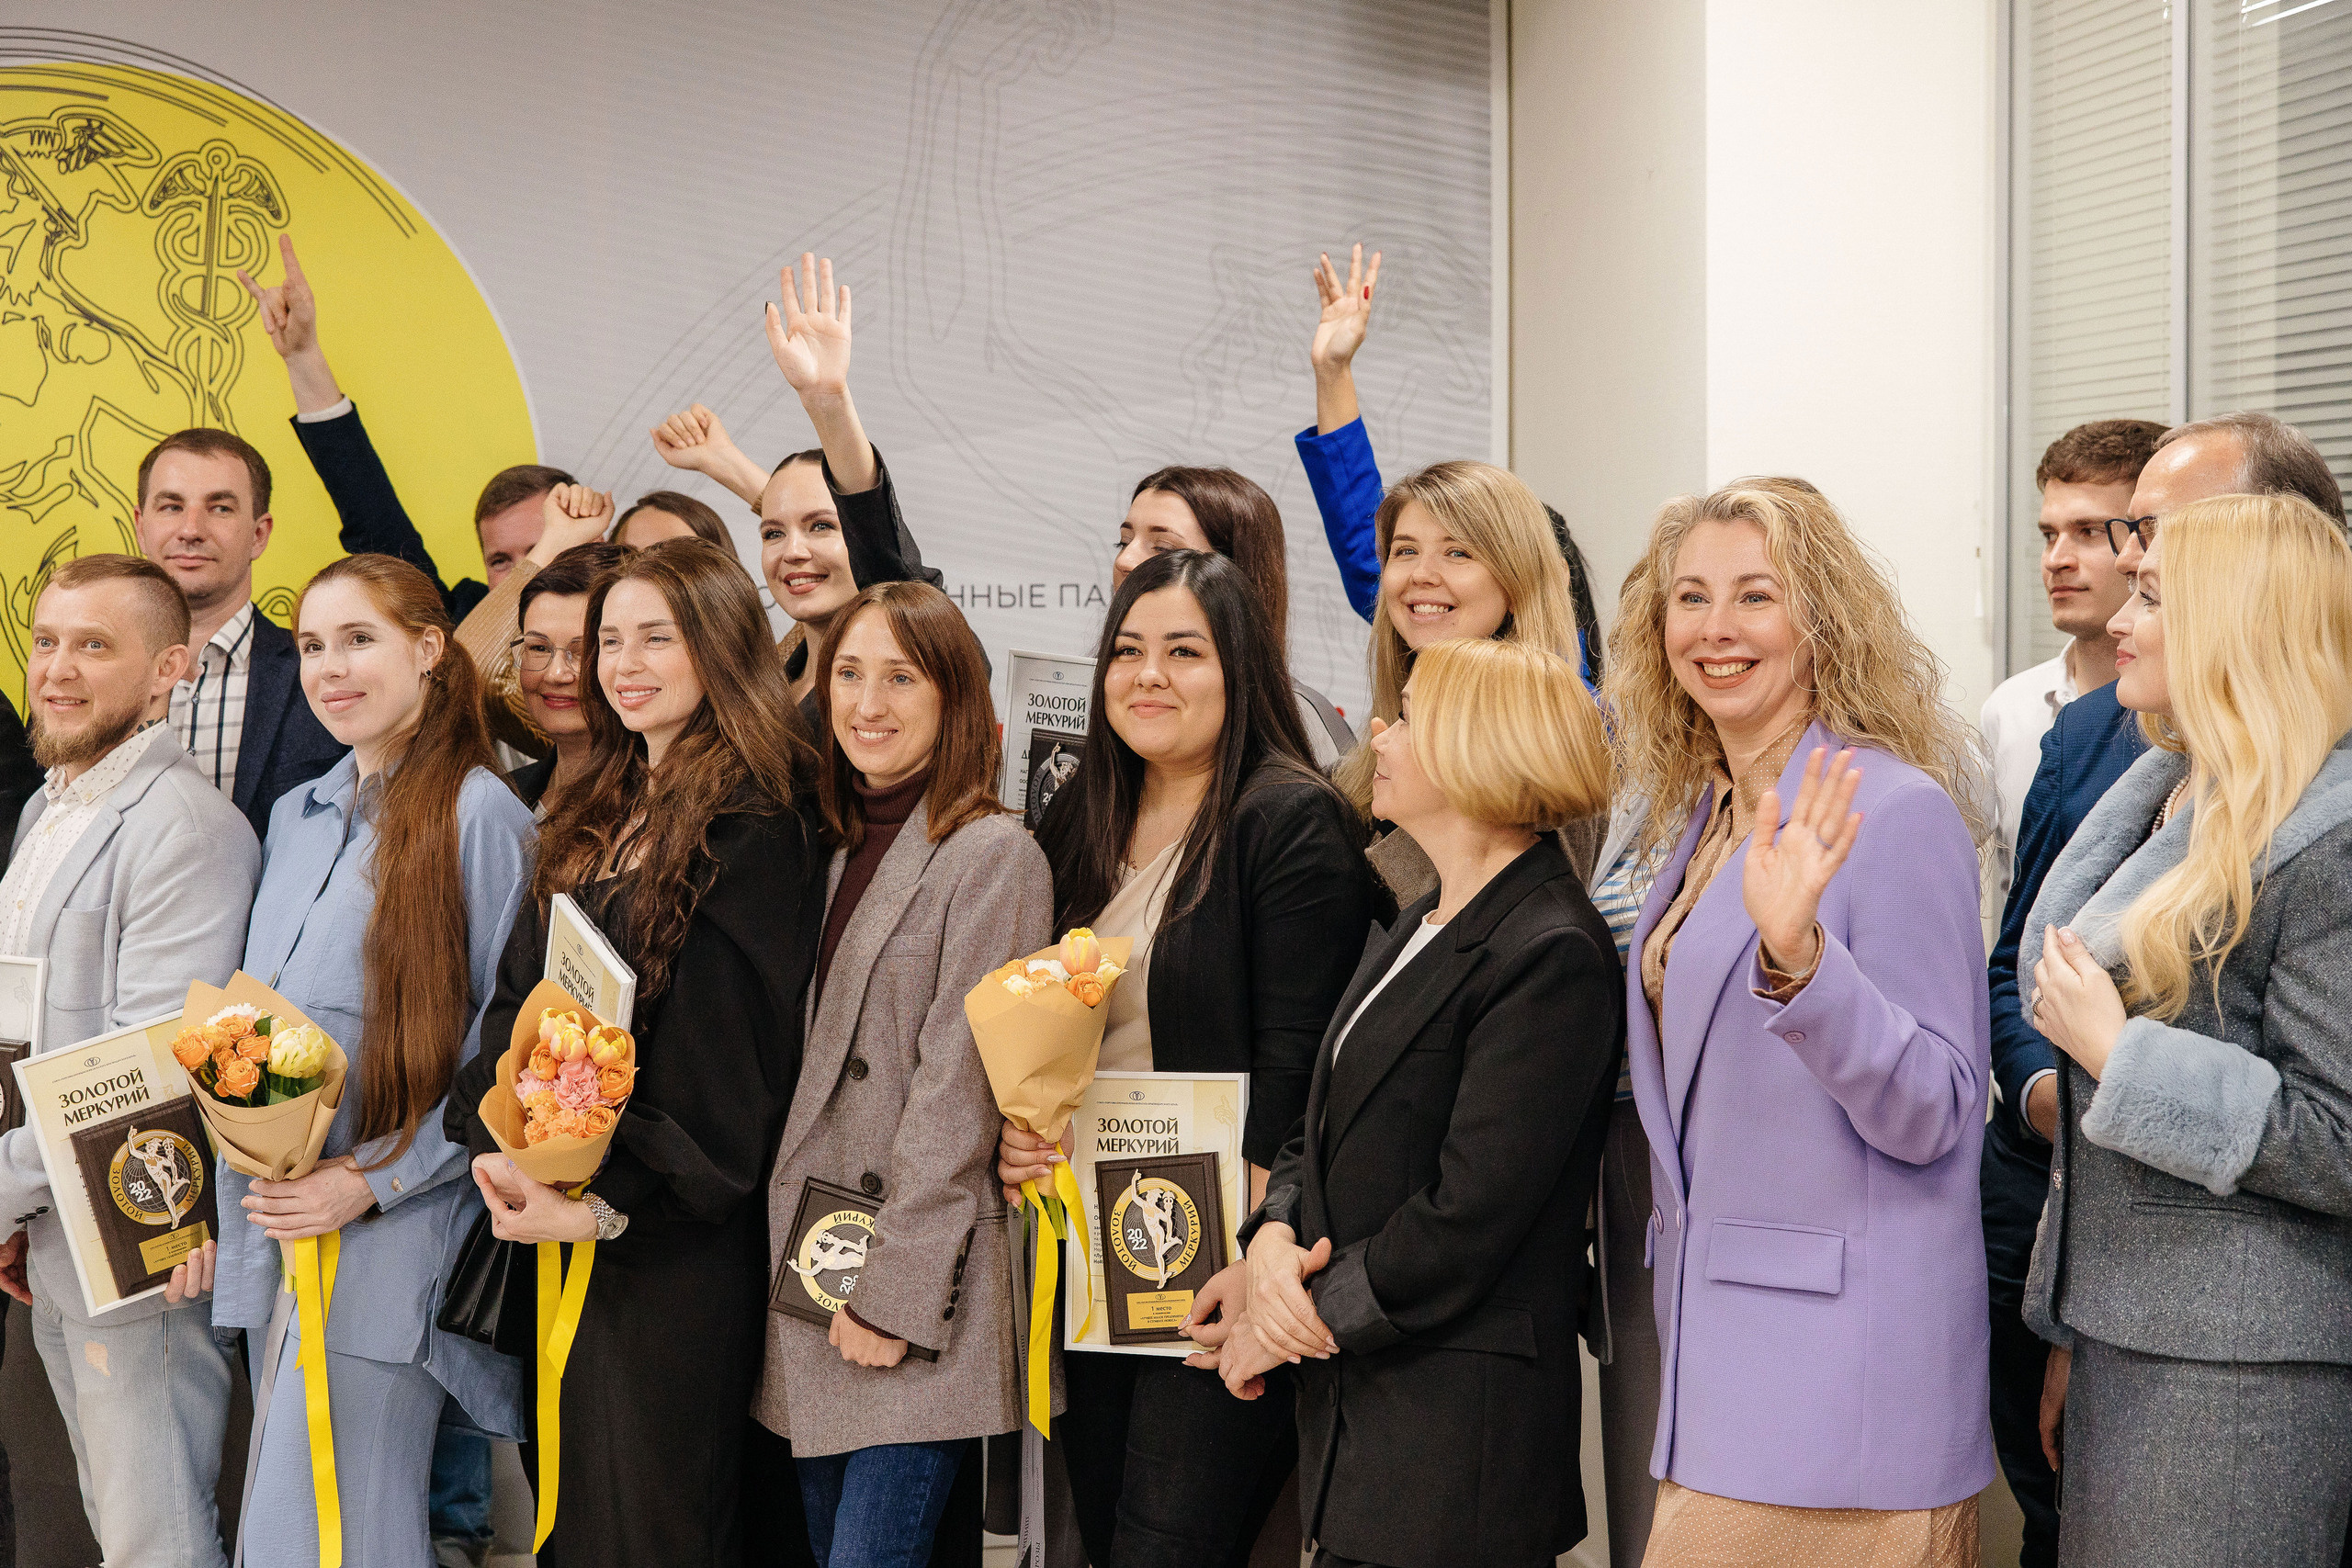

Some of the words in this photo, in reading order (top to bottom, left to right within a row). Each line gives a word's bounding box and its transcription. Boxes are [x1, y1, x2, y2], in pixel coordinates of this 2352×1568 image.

[1027, 693, 1086, 713] ЗОЛОТОЙ
[1025, 710, 1085, 730] МЕРКУРИЙ
[560, 951, 594, 1003] ЗОЛОТОЙ
[58, 1066, 144, 1109] ЗОЛОТОЙ
[63, 1084, 150, 1127] МЕРКУРИЙ
[1097, 1117, 1179, 1135] ЗОЛОТОЙ
[1096, 1136, 1180, 1155] МЕРКУРИЙ
[182, 1143, 202, 1205] МЕРКУРИЙ
[111, 1168, 143, 1220] ЗОЛОТОЙ
[129, 1180, 146, 1195] 20
[135, 1189, 153, 1203] 22
[833, 1212, 875, 1228] КУРИЙ
[1111, 1209, 1138, 1271] ЗОЛОТОЙ
[1126, 1228, 1143, 1240] 20
[1132, 1238, 1148, 1250] 22
[1179, 1200, 1199, 1269] МЕРКУРИЙ
[839, 1275, 853, 1294] 20
[815, 1292, 845, 1312] ЗОЛ
